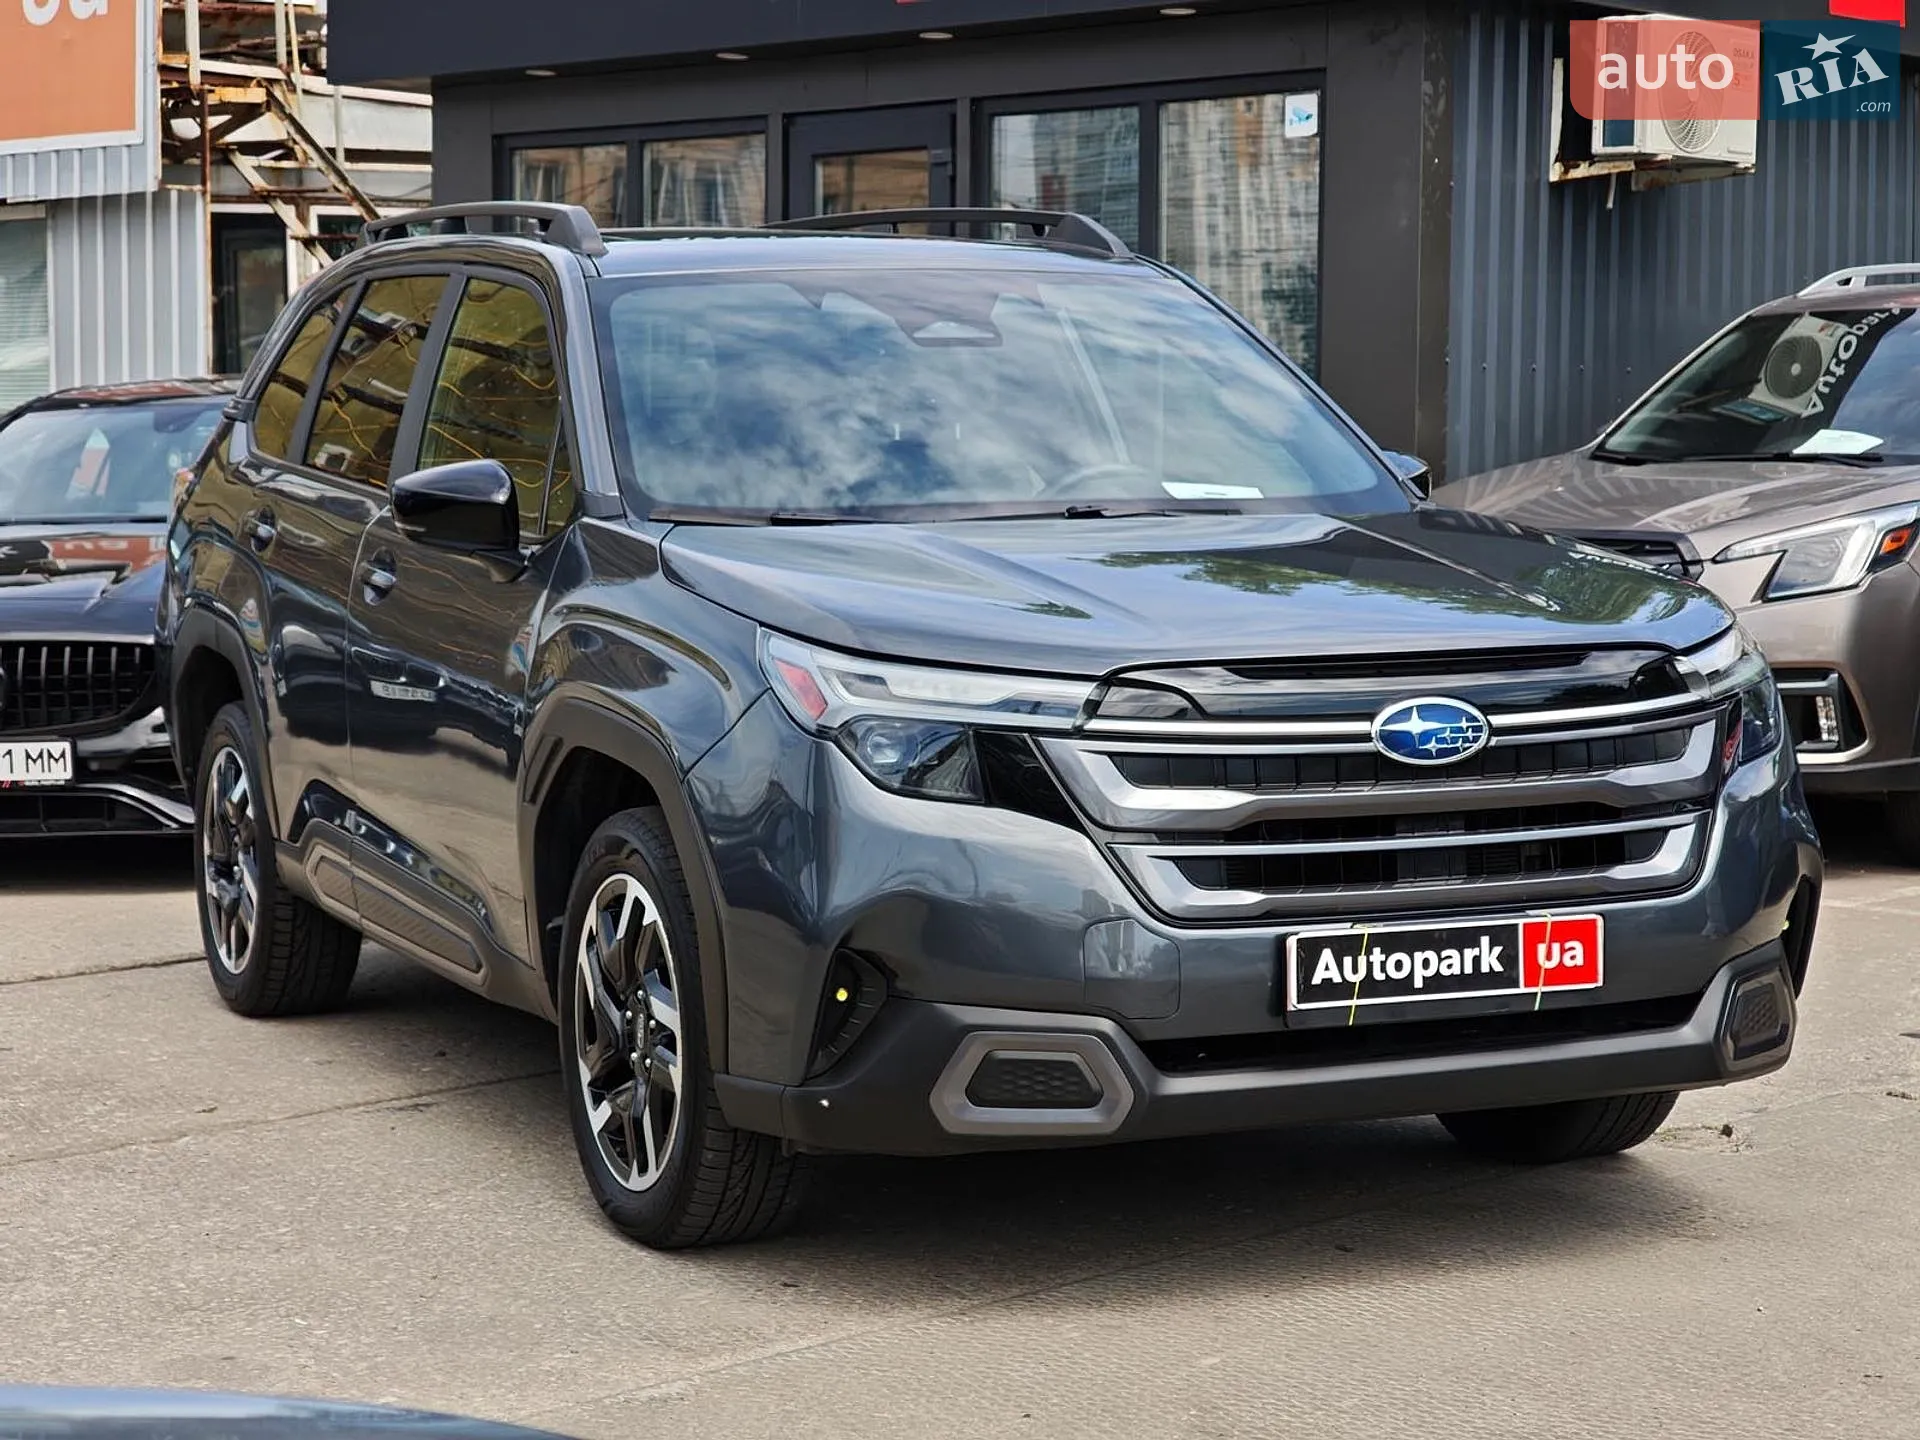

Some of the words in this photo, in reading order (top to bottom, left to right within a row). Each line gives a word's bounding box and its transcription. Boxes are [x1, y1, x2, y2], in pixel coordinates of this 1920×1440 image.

[25, 747, 68, 773] MM
[1311, 936, 1505, 989] Autopark
[1537, 939, 1585, 970] ua
